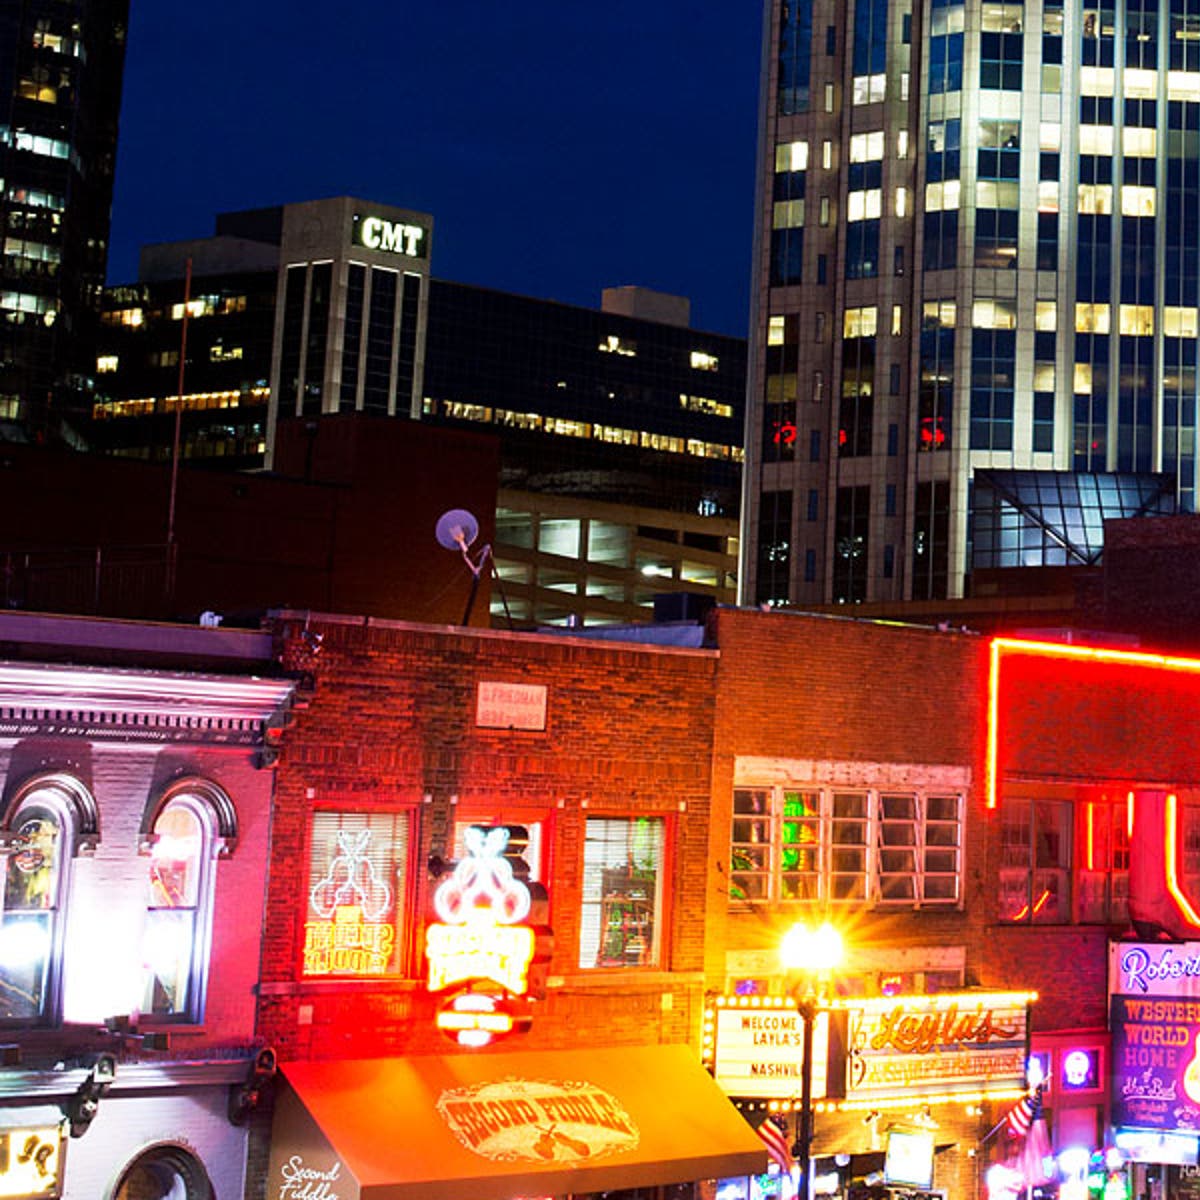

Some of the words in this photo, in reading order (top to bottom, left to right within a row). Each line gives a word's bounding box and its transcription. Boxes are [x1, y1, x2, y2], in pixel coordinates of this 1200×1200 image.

[361, 216, 424, 257] CMT
[742, 1016, 797, 1031] WELCOME
[1123, 1023, 1190, 1047] WORLD
[753, 1031, 801, 1046] LAYLA'S
[1125, 1047, 1177, 1068] HOME
[445, 1100, 540, 1148] SECOND
[534, 1092, 638, 1136] FIDDLE
[281, 1155, 341, 1181] Second
